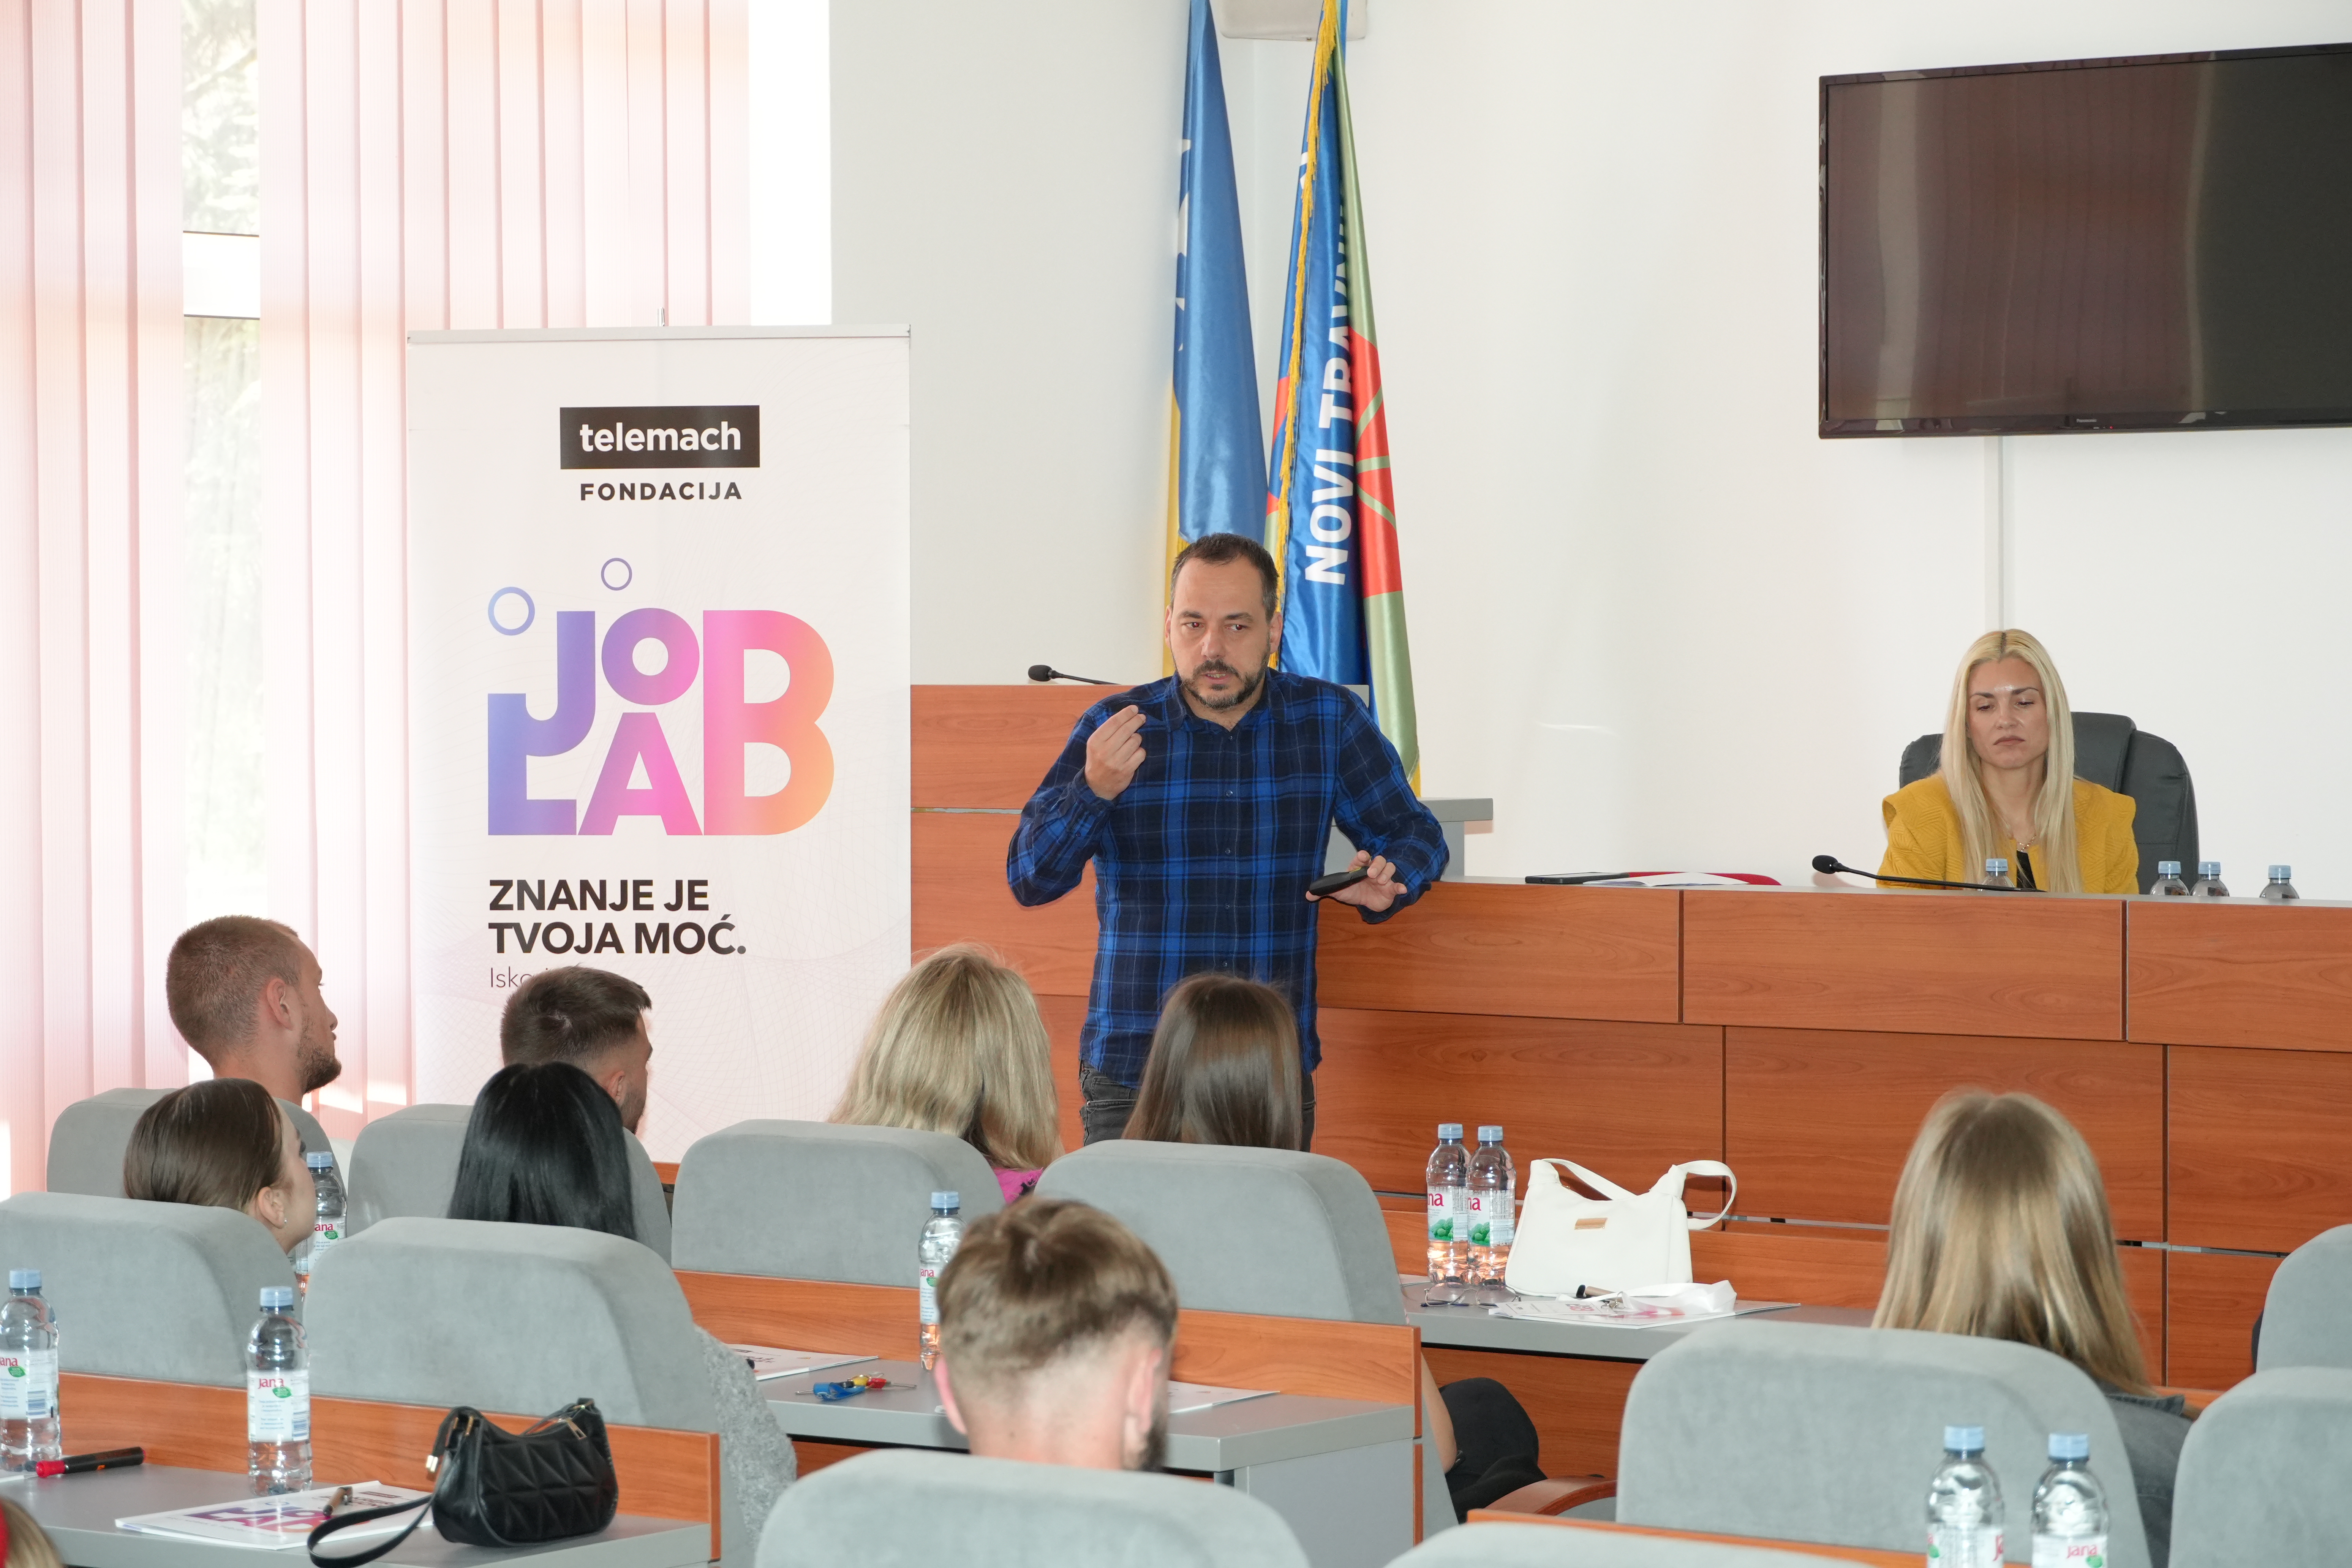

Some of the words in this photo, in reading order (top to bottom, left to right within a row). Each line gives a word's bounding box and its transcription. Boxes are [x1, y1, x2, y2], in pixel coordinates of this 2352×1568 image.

[580, 421, 741, 452] telemach
[580, 482, 742, 501] FONDACIJA
[1305, 449, 1354, 585] NOVI
[525, 608, 835, 757] JOB
[488, 693, 835, 836] LAB
[489, 879, 654, 911] ZNANJE
[664, 879, 709, 912] JE
[488, 922, 625, 954] TVOJA
[635, 914, 746, 955] MOĆ.
[1428, 1193, 1445, 1207] na
[1467, 1197, 1482, 1211] na
[0, 1357, 19, 1366] ana
